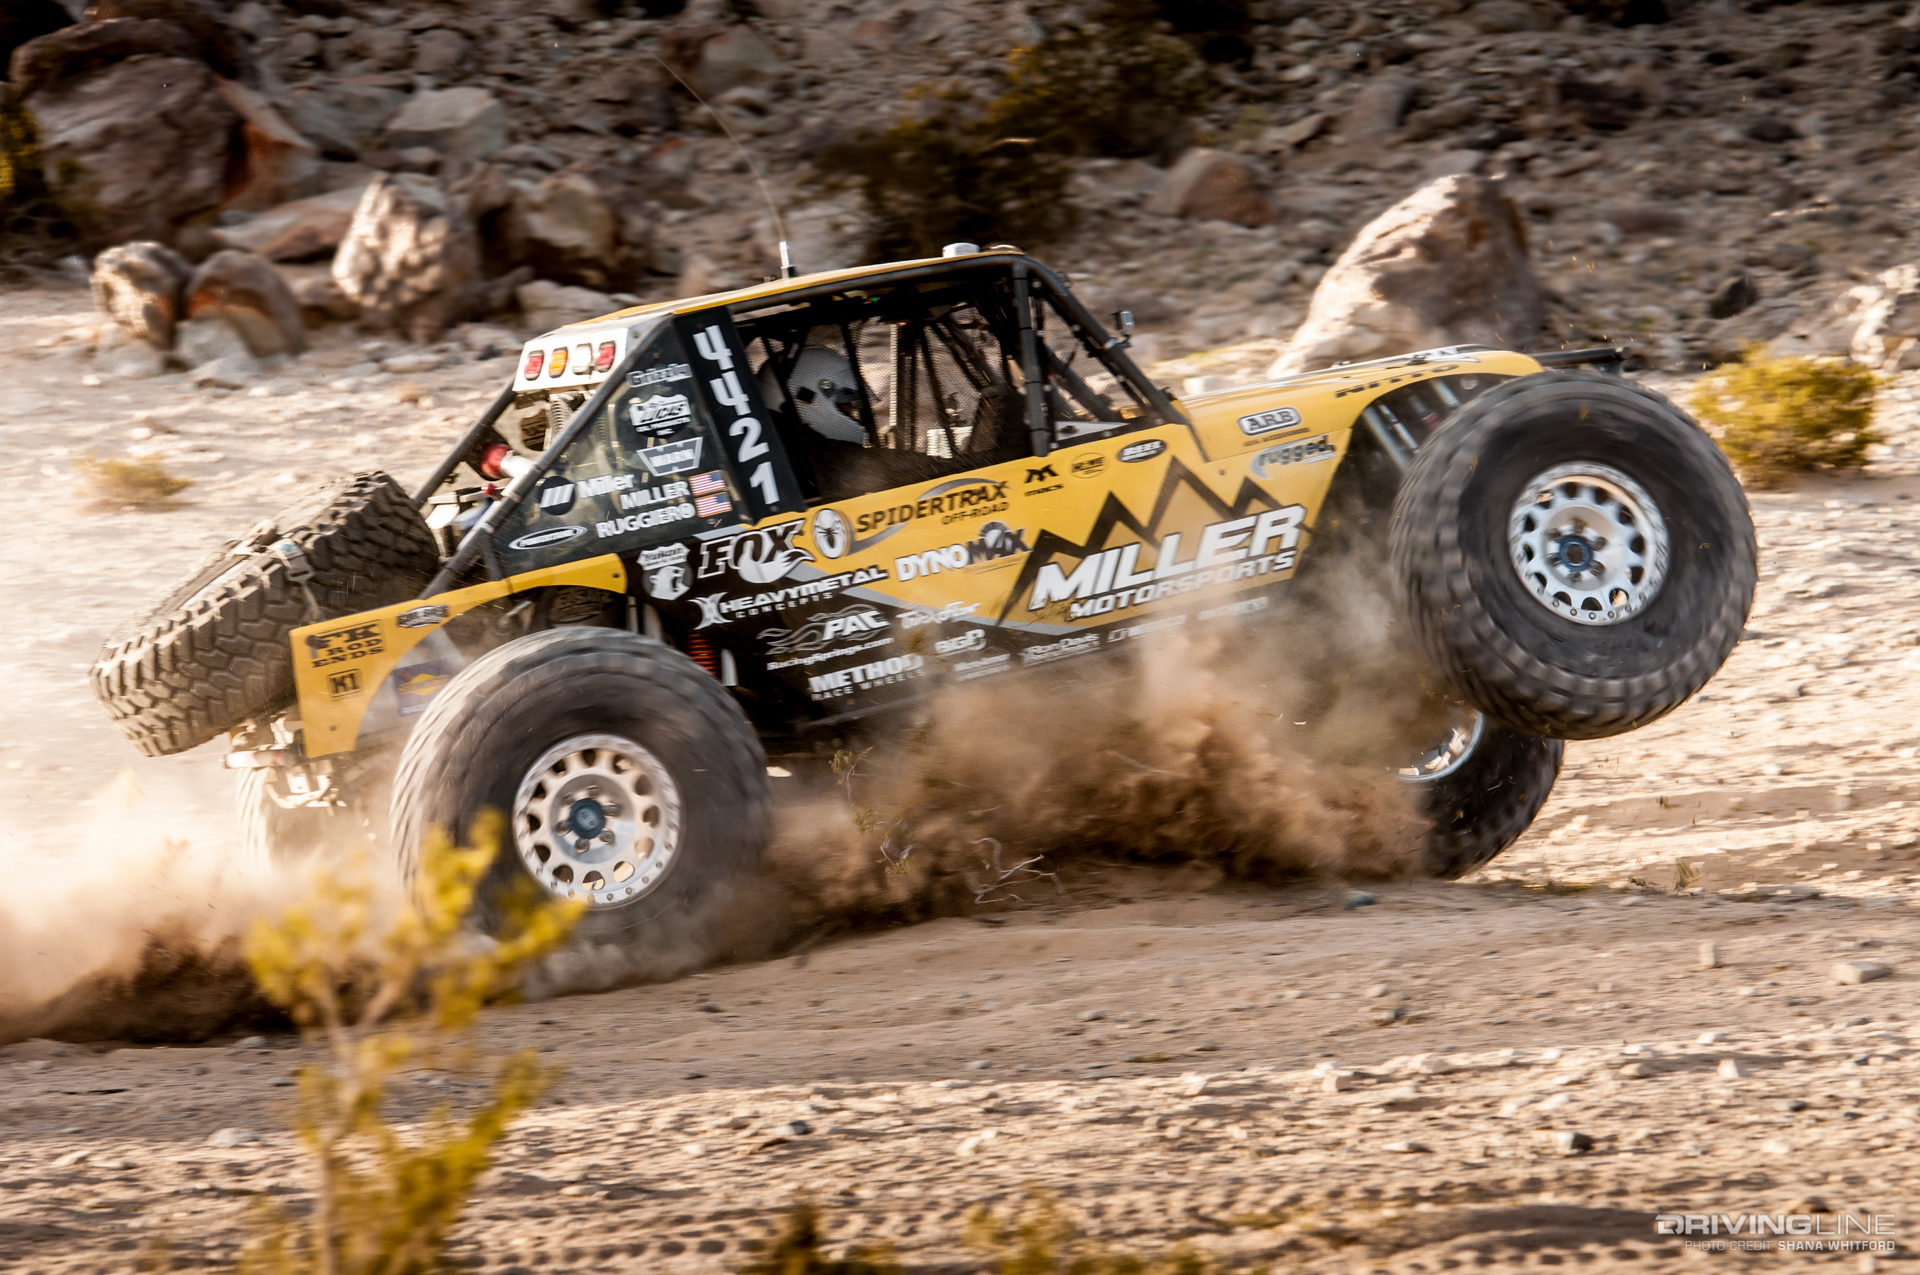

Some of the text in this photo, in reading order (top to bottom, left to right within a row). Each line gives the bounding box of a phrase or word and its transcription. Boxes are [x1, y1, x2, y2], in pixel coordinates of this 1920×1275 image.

[693, 325, 780, 505] 4421
[1247, 411, 1293, 432] ARB
[577, 474, 634, 498] Miller
[620, 480, 690, 510] MILLER
[595, 502, 696, 538] RUGGIERO
[856, 480, 1008, 533] SPIDERTRAX
[697, 518, 808, 579] FOX
[895, 526, 1034, 582] DYNOMAX
[1028, 504, 1306, 611] MILLER
[720, 567, 888, 614] HEAVYMETAL
[1069, 550, 1297, 619] MOTORSPORTS
[822, 610, 890, 641] PAC
[311, 646, 385, 668] ENDS
[326, 638, 383, 657] ROD
[808, 653, 924, 693] METHOD
